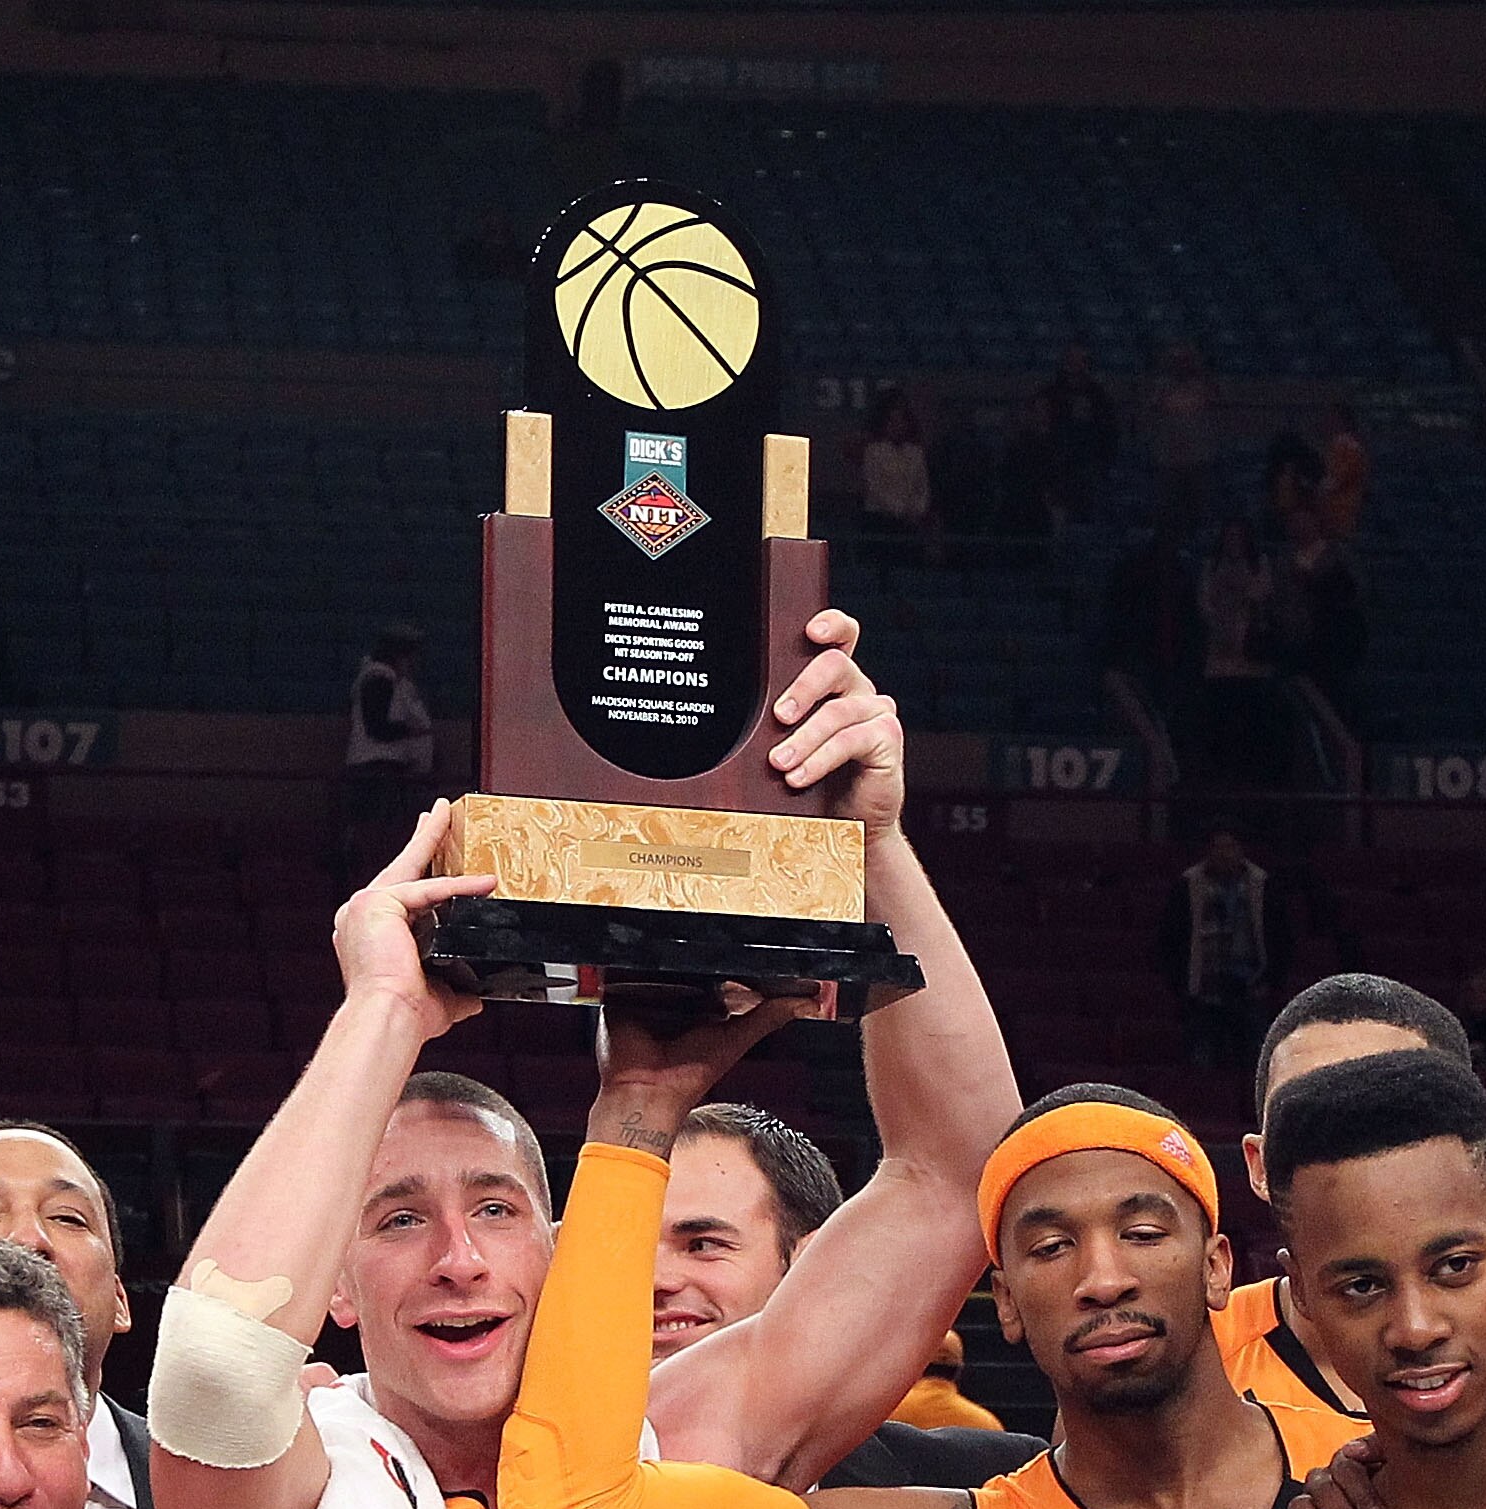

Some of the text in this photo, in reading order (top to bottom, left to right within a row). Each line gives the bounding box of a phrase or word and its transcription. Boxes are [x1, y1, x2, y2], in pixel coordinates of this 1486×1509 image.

[629, 438, 683, 461] DICK'S
[628, 504, 683, 526] NIT
[604, 602, 704, 619] PETER A. CARLESIMO
[608, 616, 699, 632] MEMORIAL AWARD
[605, 634, 705, 650] DICK'S SPORTING GOODS
[629, 648, 663, 660] SEASON
[663, 651, 694, 662] TIP-OFF
[603, 666, 709, 687] CHAMPIONS
[592, 696, 715, 713] MADISON SQUARE GARDEN
[608, 709, 659, 722] NOVEMBER
[676, 714, 699, 725] 2010
[1, 719, 100, 764] 107
[1026, 747, 1120, 790] 107
[950, 805, 988, 832] 55
[628, 851, 704, 869] CHAMPIONS
